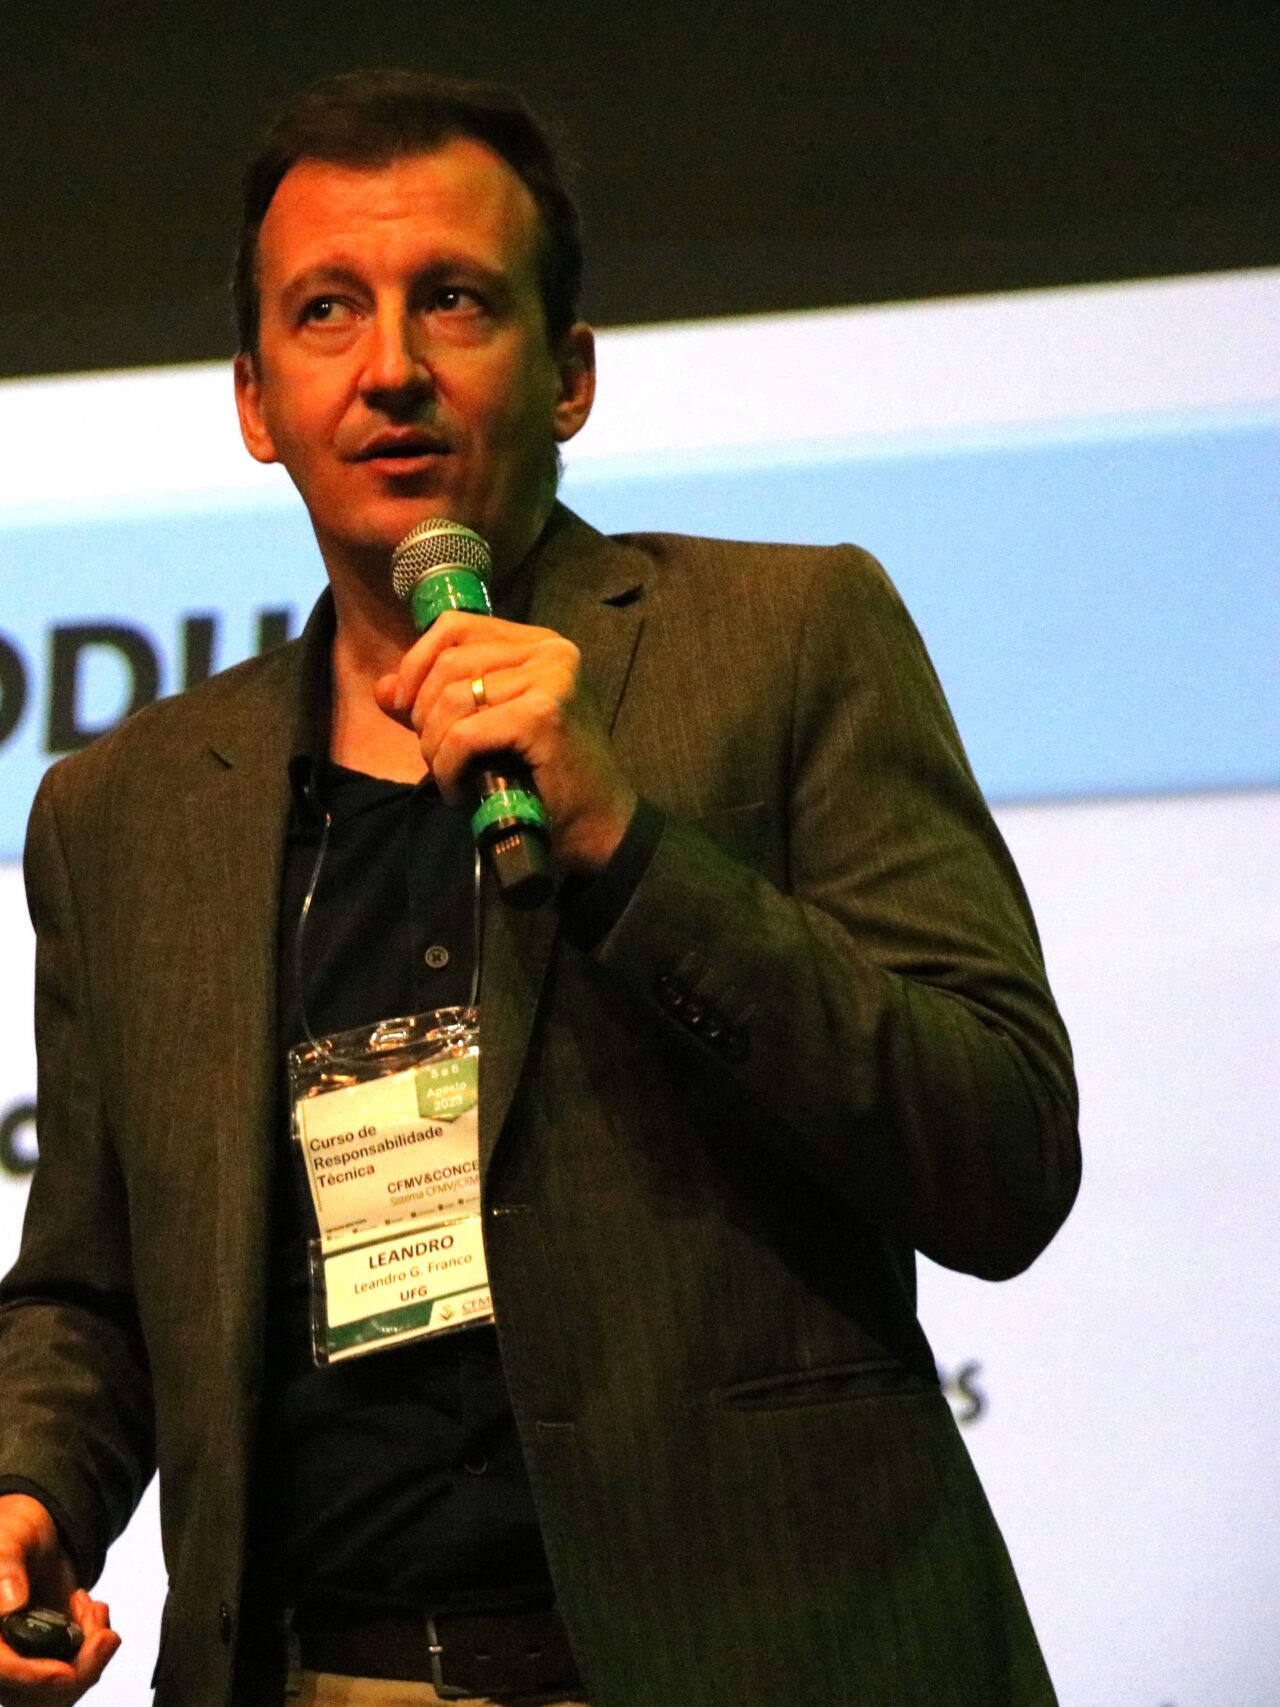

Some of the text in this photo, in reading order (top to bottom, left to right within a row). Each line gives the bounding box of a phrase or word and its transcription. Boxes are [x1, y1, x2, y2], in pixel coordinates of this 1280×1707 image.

[310, 1125, 377, 1152] Curso de
[314, 1125, 444, 1170] Responsabilidade
[317, 1163, 376, 1188] Técnica
[368, 1234, 454, 1270] LEANDRO
[354, 1254, 473, 1295] Leandro G. Franco
[400, 1284, 428, 1302] UFG
